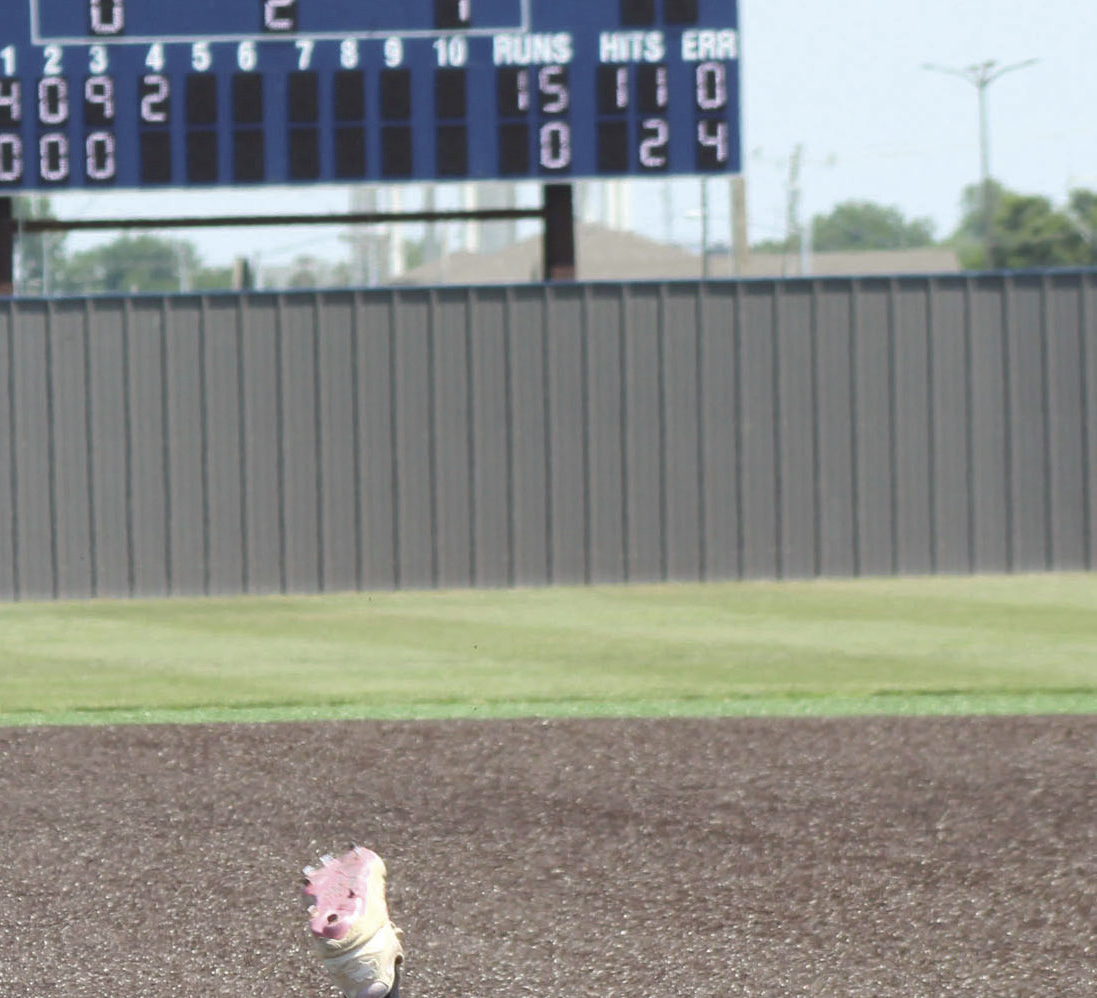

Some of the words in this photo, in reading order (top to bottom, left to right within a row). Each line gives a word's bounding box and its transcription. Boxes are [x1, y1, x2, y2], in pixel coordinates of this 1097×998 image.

[0, 46, 15, 75] 1
[43, 45, 63, 75] 2
[89, 45, 108, 73] 3
[145, 41, 165, 71] 4
[191, 41, 212, 71] 5
[237, 41, 257, 71] 6
[295, 39, 315, 70] 7
[339, 38, 359, 69] 8
[384, 37, 403, 67] 9
[433, 36, 466, 67] 10
[492, 33, 573, 65] RUNS
[599, 31, 665, 63] HITS
[681, 30, 738, 61] ERR
[39, 77, 68, 124] 0
[85, 76, 114, 119] 9
[141, 75, 169, 122] 2
[518, 65, 569, 112] 15
[617, 68, 668, 107] 11
[696, 62, 726, 109] 0
[40, 134, 68, 181] 0
[86, 132, 115, 179] 0
[540, 121, 570, 169] 0
[640, 119, 668, 167] 2
[698, 122, 727, 162] 4
